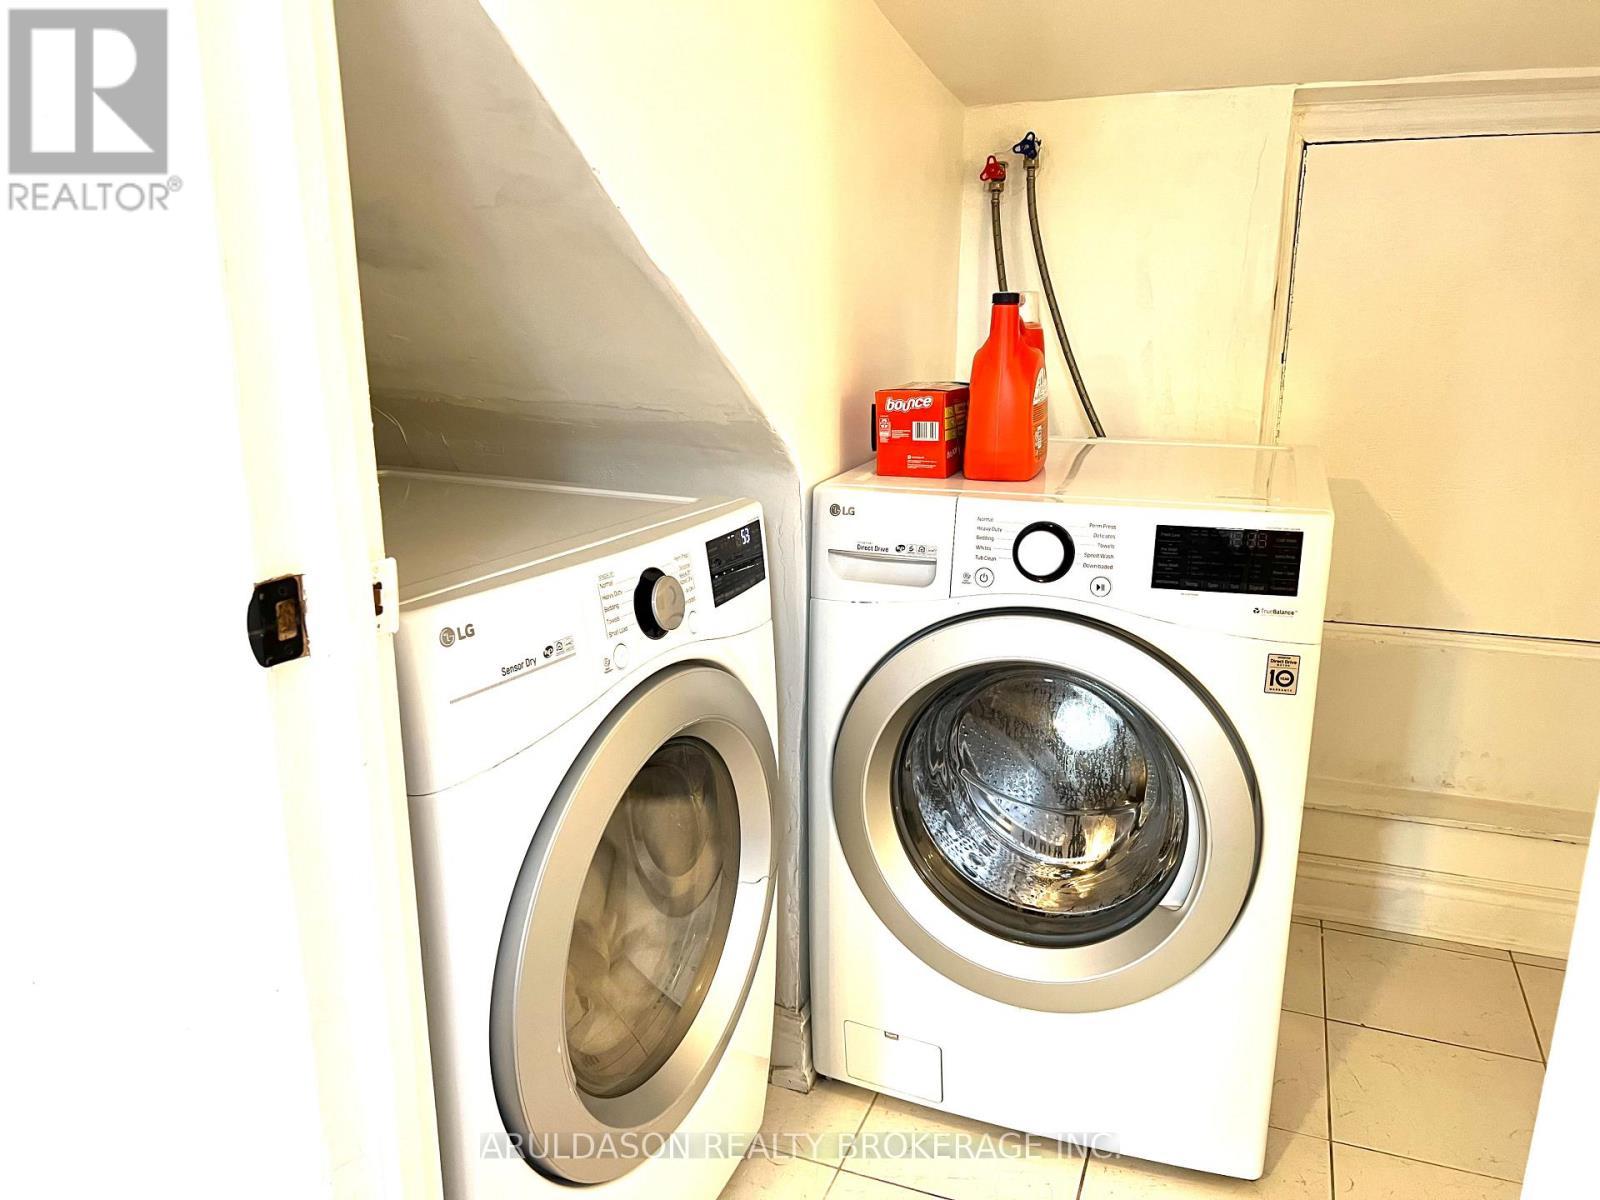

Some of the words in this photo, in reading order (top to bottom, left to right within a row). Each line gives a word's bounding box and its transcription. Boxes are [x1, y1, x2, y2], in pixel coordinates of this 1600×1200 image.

[885, 395, 934, 413] bounce
[842, 506, 856, 516] LG
[856, 543, 874, 552] Direct
[874, 545, 889, 553] Drive
[457, 623, 476, 641] LG
[501, 660, 525, 677] Sensor
[525, 657, 537, 668] Dry
[1269, 669, 1295, 688] 10
